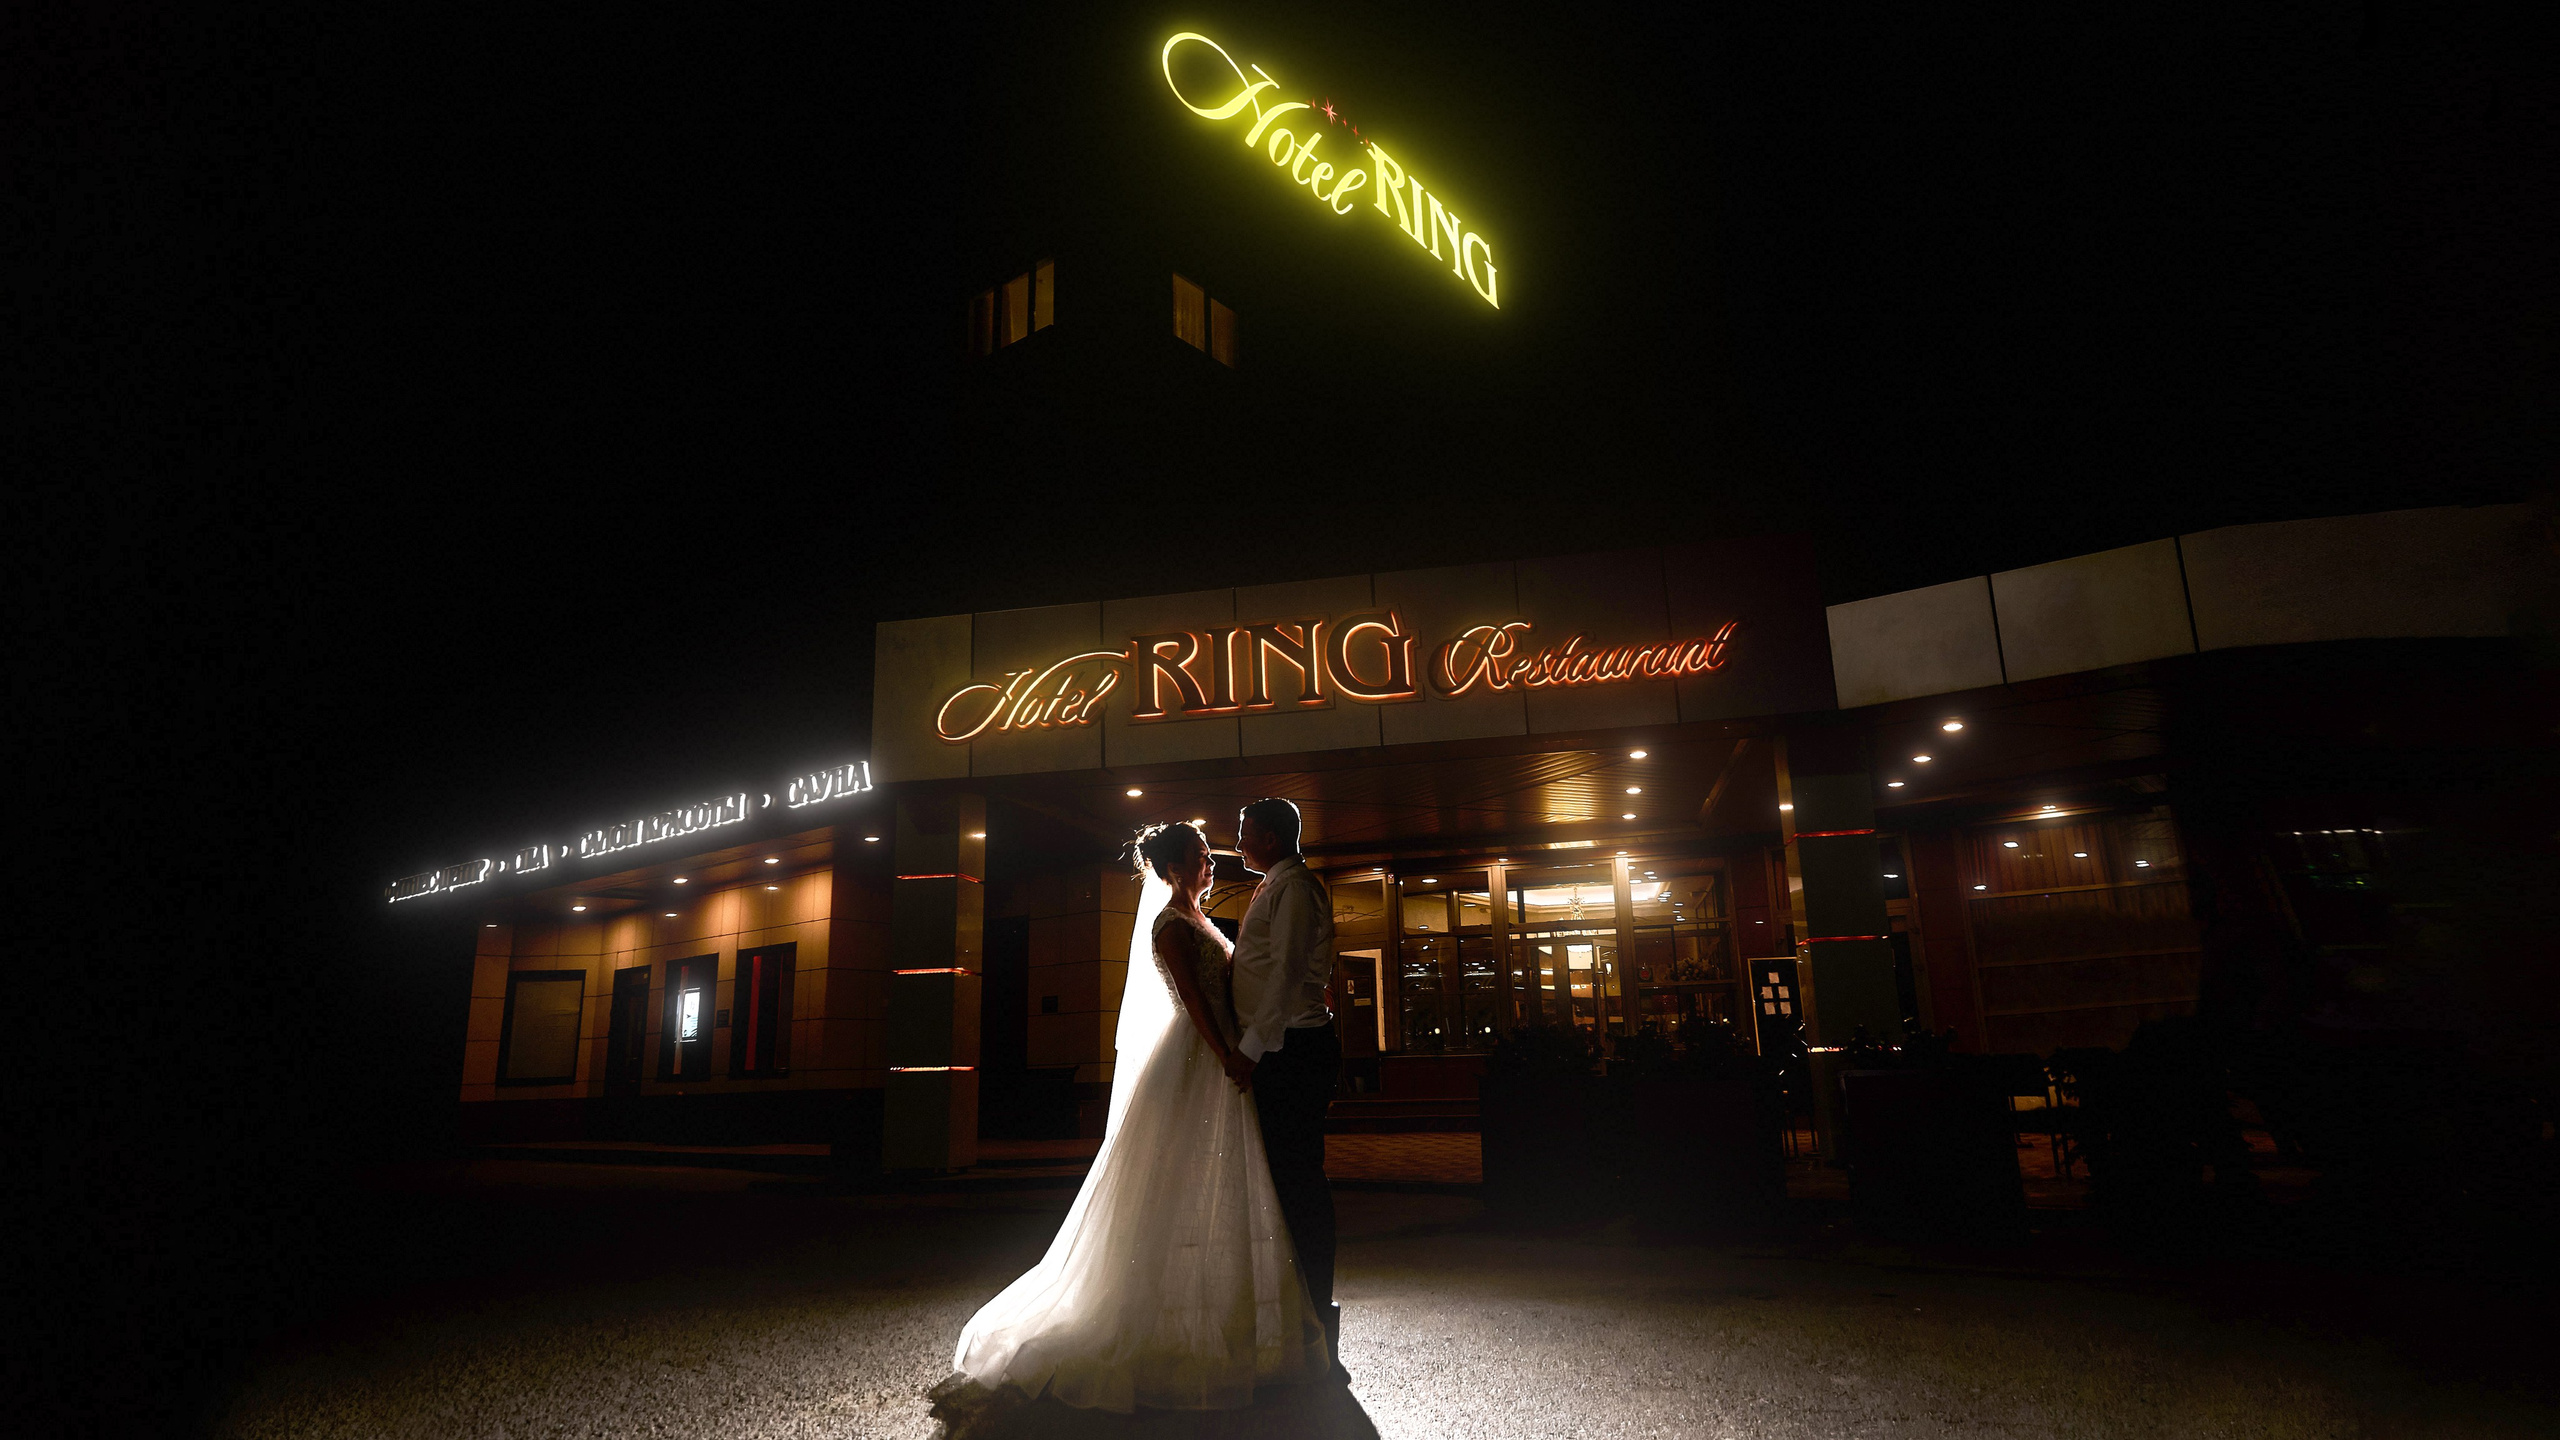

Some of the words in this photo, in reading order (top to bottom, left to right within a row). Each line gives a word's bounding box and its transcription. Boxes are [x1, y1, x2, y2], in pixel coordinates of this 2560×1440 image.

[1161, 31, 1367, 215] Hotel
[1366, 141, 1500, 310] RING
[935, 649, 1131, 743] Hotel
[1130, 611, 1418, 718] RING
[1430, 620, 1740, 696] Restaurant
[787, 760, 873, 808] САУНА
